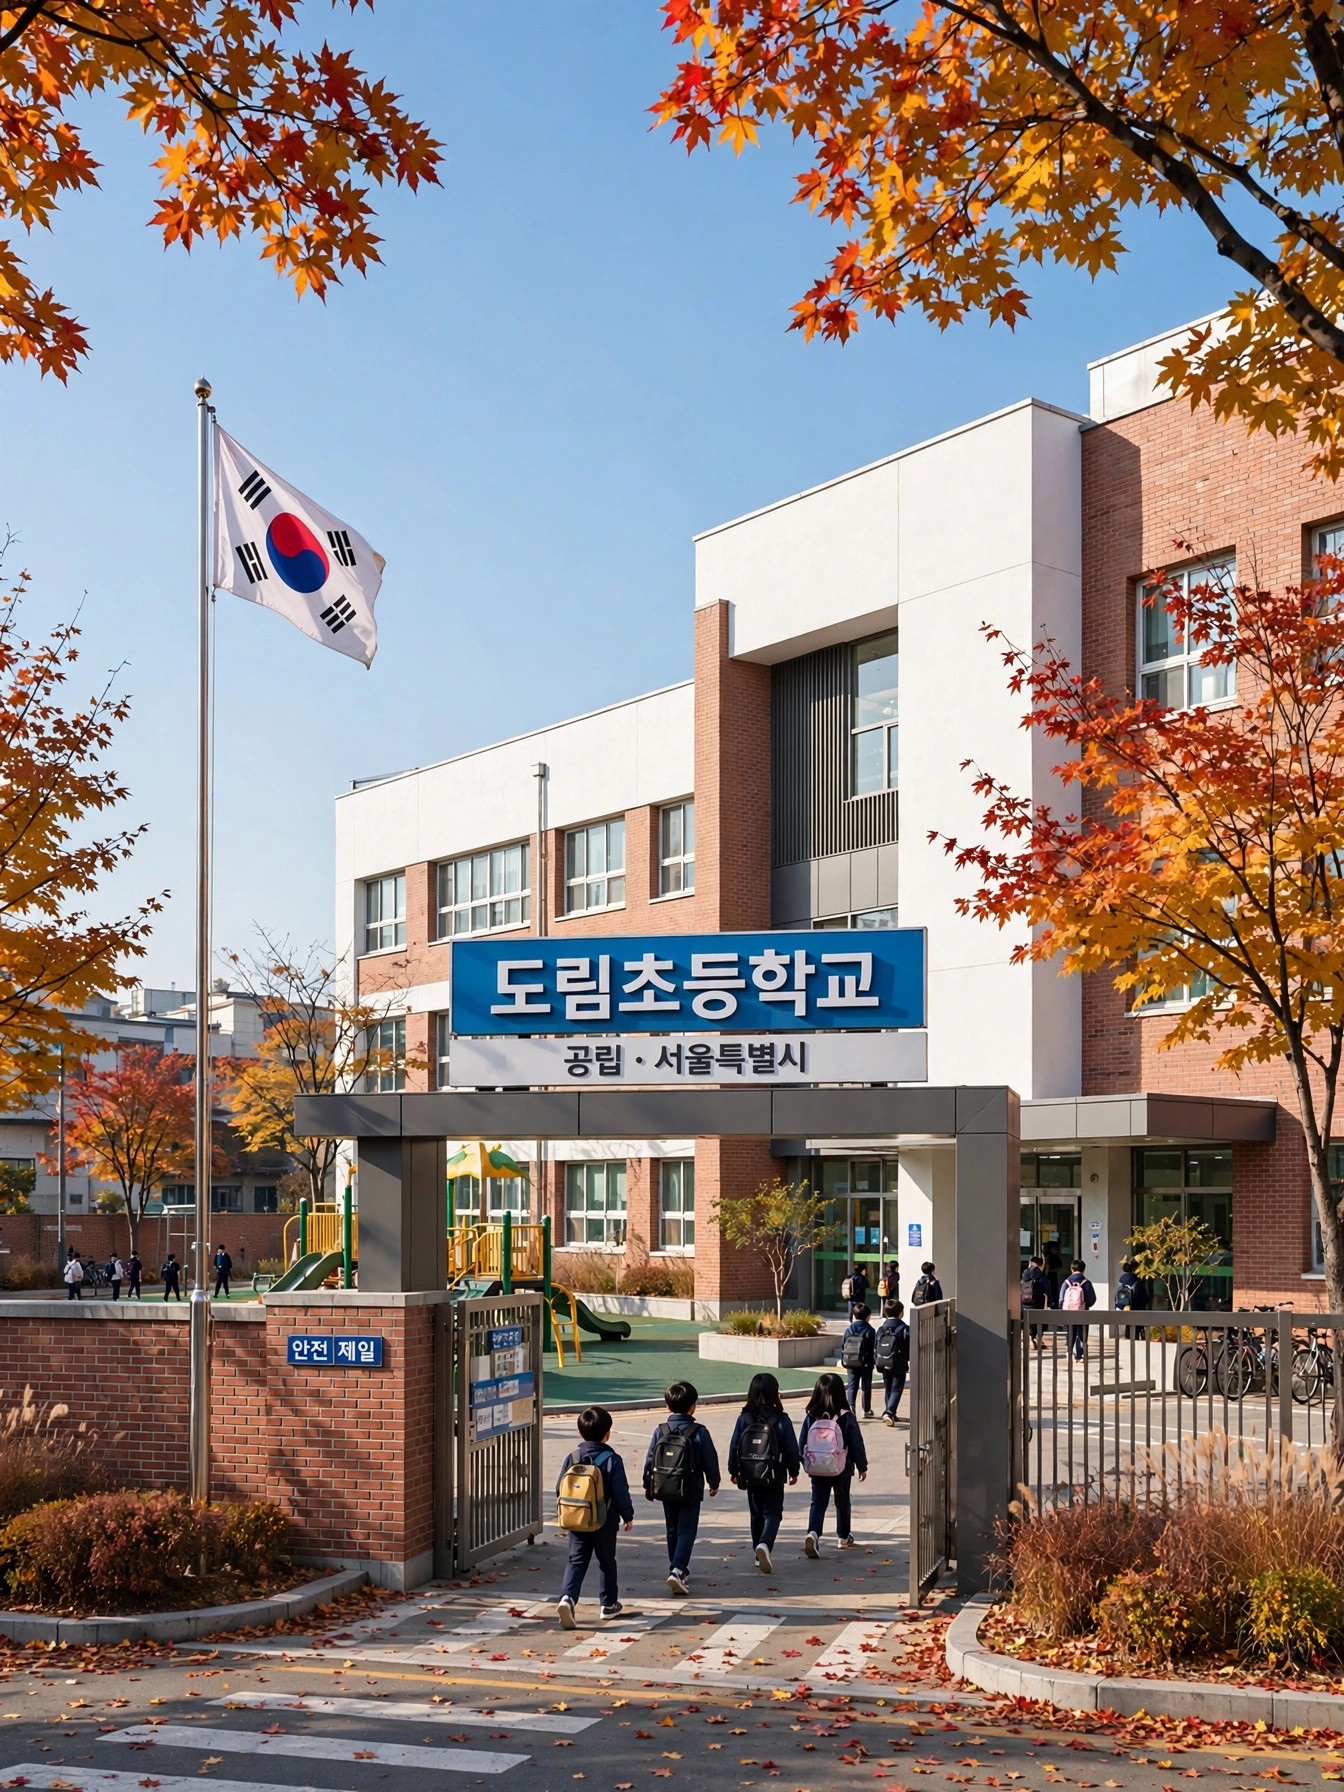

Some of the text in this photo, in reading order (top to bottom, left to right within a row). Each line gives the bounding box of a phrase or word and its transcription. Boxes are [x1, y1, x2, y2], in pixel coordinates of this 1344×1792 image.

[490, 948, 880, 1020] 도림초등학교
[563, 1044, 622, 1078] 공립
[654, 1041, 806, 1076] 서울특별시
[292, 1339, 375, 1362] 안전 제일
